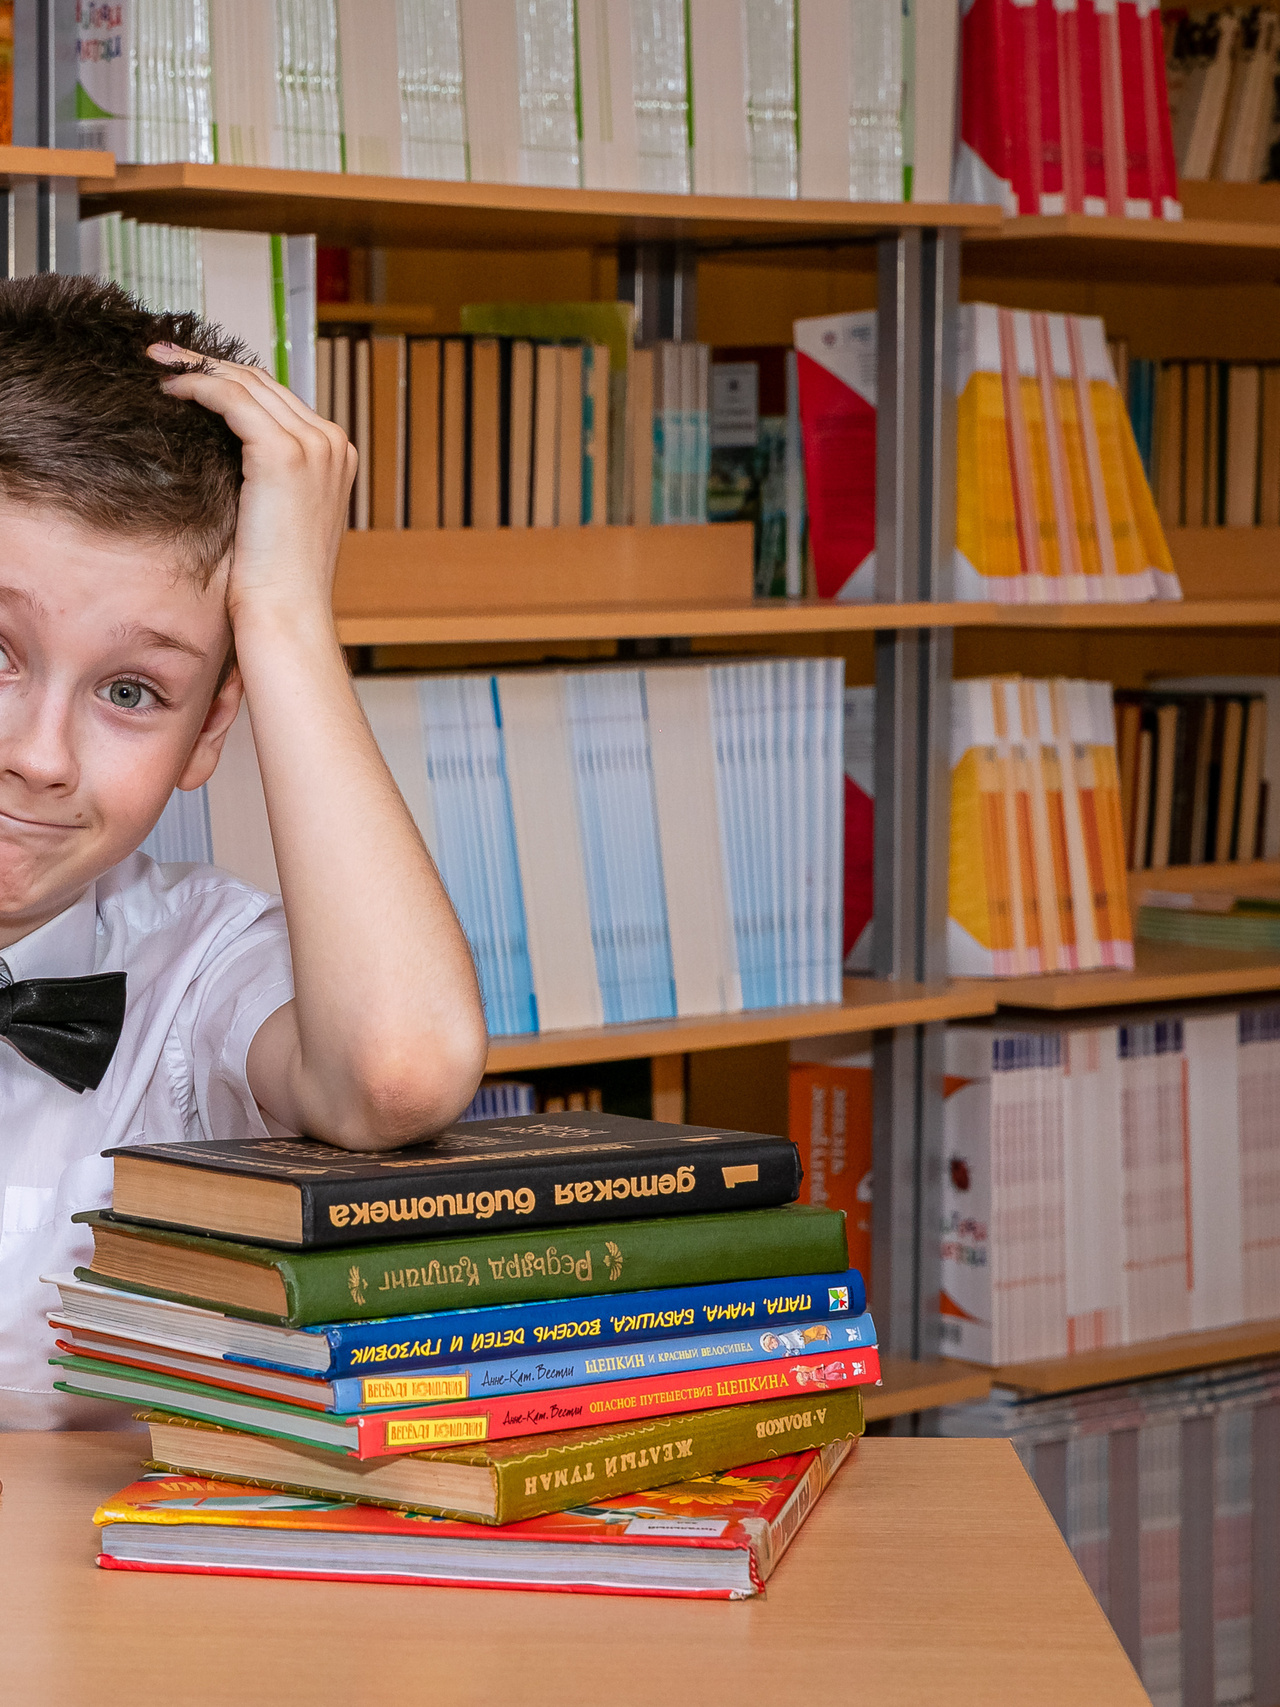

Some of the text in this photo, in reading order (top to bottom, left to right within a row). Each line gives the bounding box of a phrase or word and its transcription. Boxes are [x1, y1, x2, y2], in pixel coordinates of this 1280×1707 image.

[328, 1165, 697, 1228] детская библиотека
[721, 1164, 759, 1189] 1
[378, 1246, 593, 1291] Редьярд Киплинг
[350, 1293, 812, 1365] ПАПА, МАМА, БАБУШКА, ВОСЕМЬ ДЕТЕЙ И ГРУЗОВИК
[585, 1354, 645, 1375] ЩЕПКИН
[658, 1349, 699, 1363] КРАСНЫЙ
[701, 1342, 753, 1357] ВЕЛОСИПЕД
[589, 1373, 790, 1414] ОПАСНОЕ ПУТЕШЕСТВИЕ ЩЕПКИНА
[525, 1438, 693, 1496] ЖЕЛТЫЙ ТУМАН
